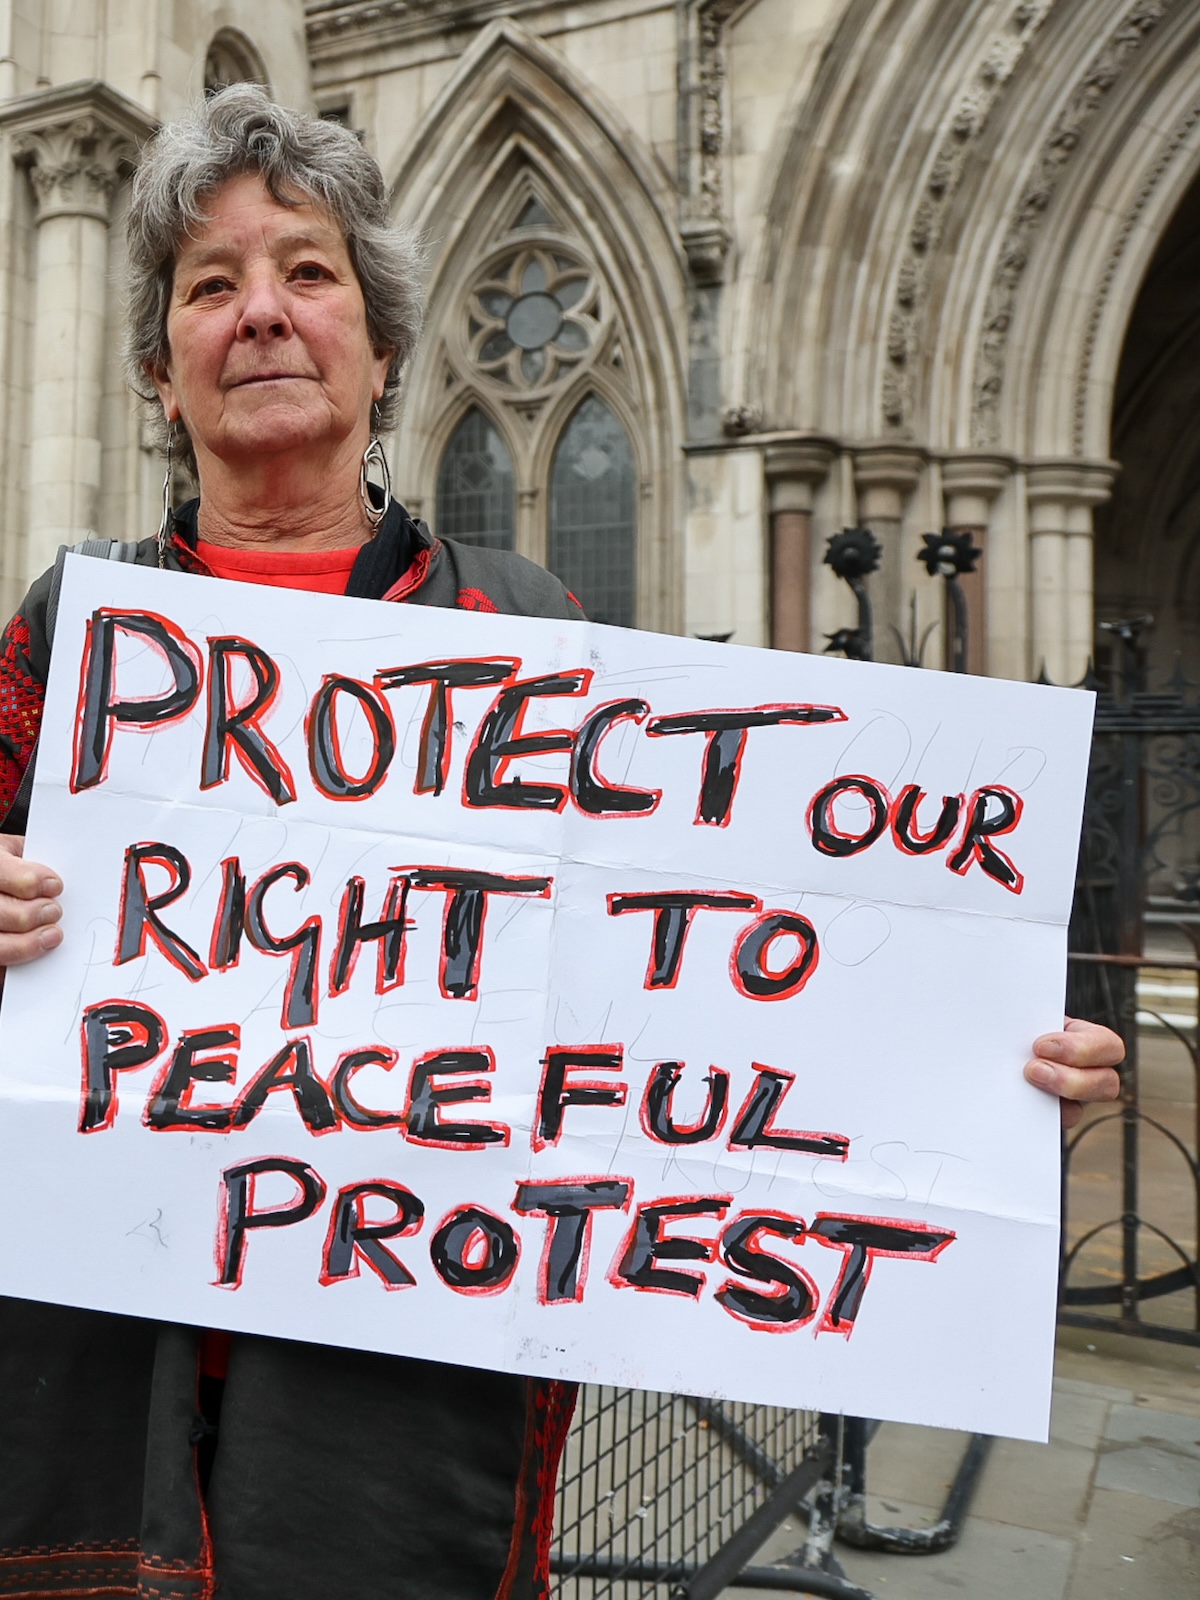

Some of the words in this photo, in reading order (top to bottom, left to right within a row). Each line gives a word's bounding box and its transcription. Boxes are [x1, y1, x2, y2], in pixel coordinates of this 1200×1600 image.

[70, 607, 848, 828] PROTECT
[805, 774, 1024, 895] OUR
[113, 841, 553, 1029] RIGHT
[606, 890, 819, 1002] TO
[208, 1154, 958, 1342] PROTEST
